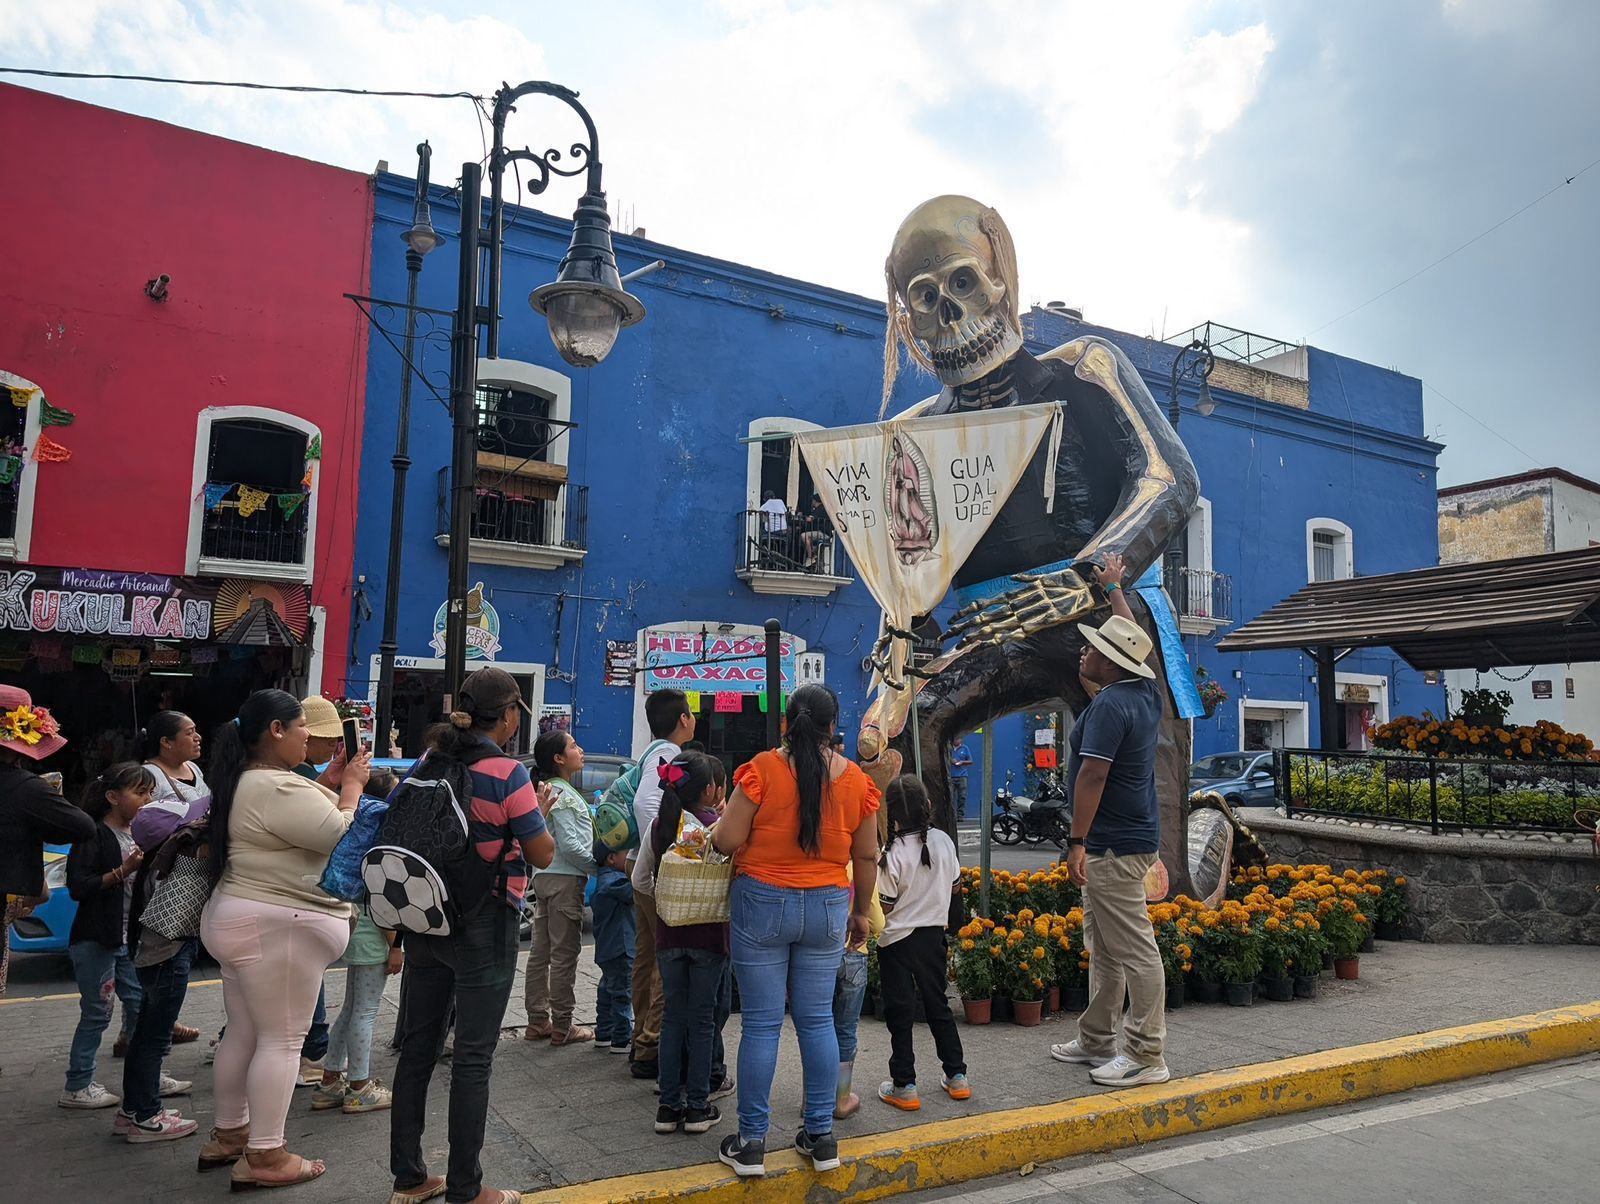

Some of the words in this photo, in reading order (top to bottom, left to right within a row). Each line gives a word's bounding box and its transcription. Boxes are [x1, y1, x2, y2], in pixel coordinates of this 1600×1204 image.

[950, 455, 995, 479] GUA
[953, 478, 997, 504] DAL
[955, 500, 992, 523] UPE
[62, 570, 116, 589] Mercadito
[119, 574, 171, 593] Artesanal
[648, 636, 792, 656] HELADOS
